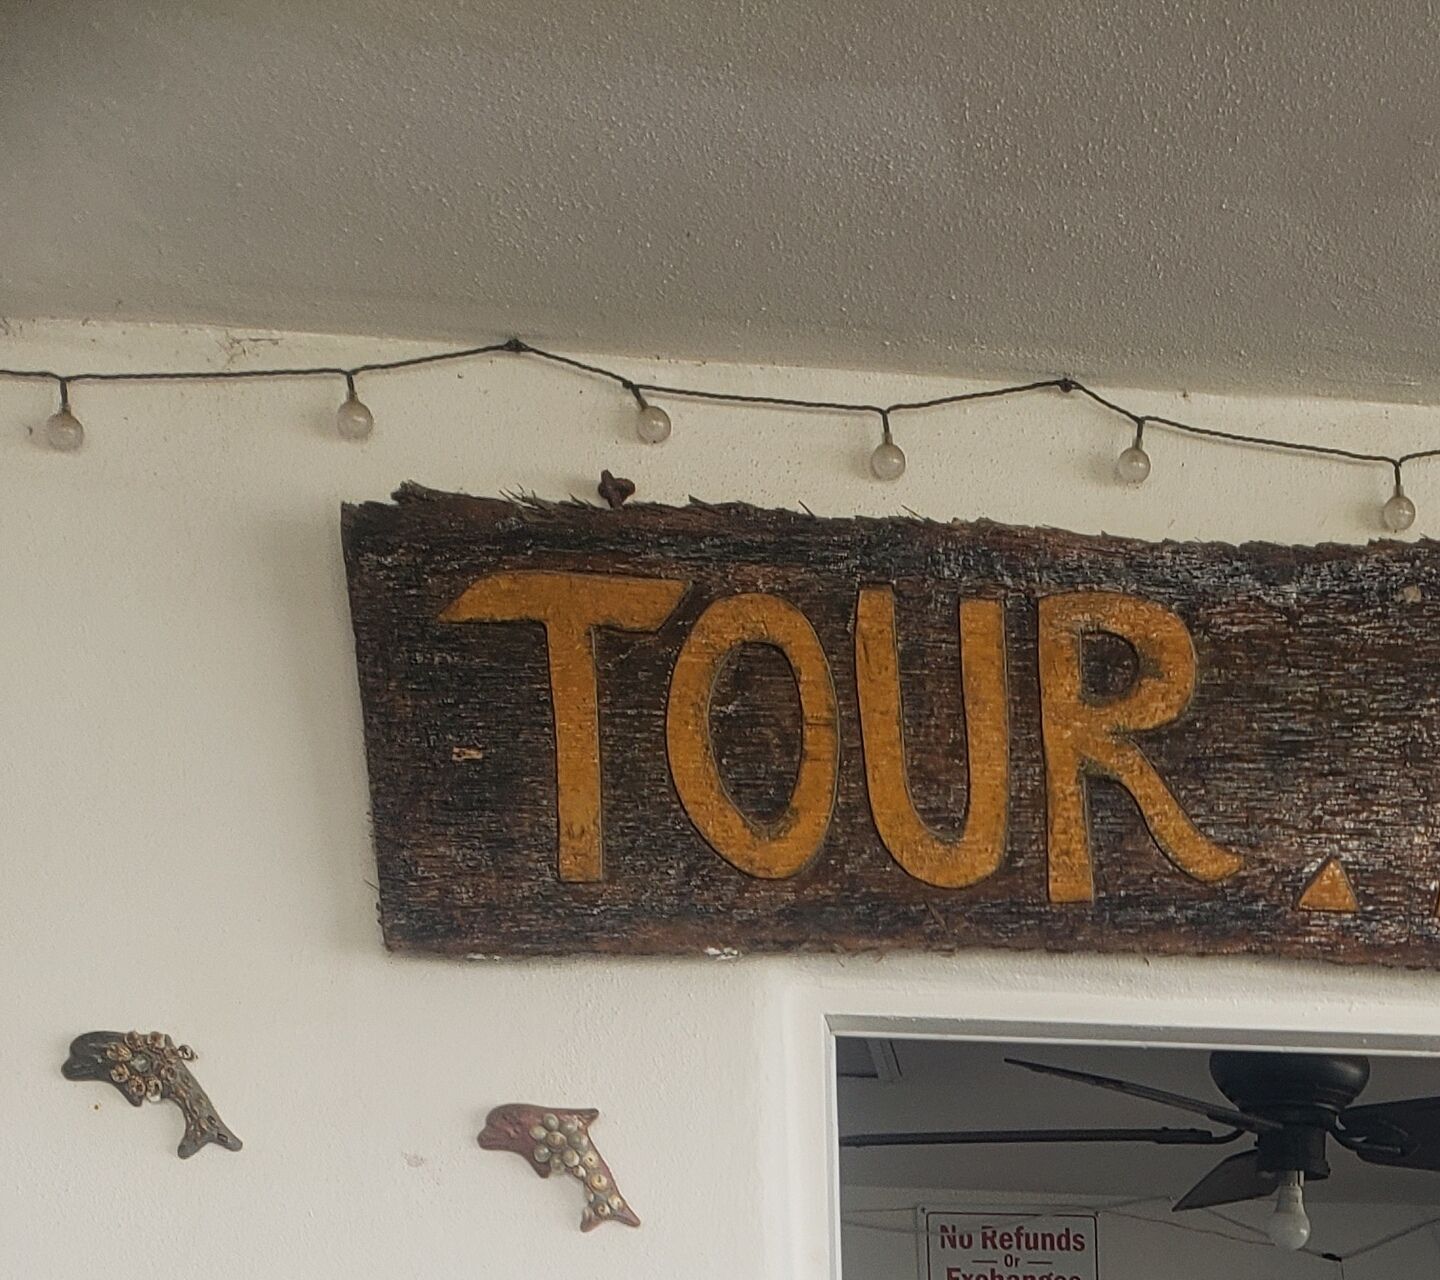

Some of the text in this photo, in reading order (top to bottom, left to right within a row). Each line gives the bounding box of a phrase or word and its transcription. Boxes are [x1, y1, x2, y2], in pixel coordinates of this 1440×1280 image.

[940, 1224, 1086, 1252] No Refunds
[1004, 1254, 1020, 1268] Or
